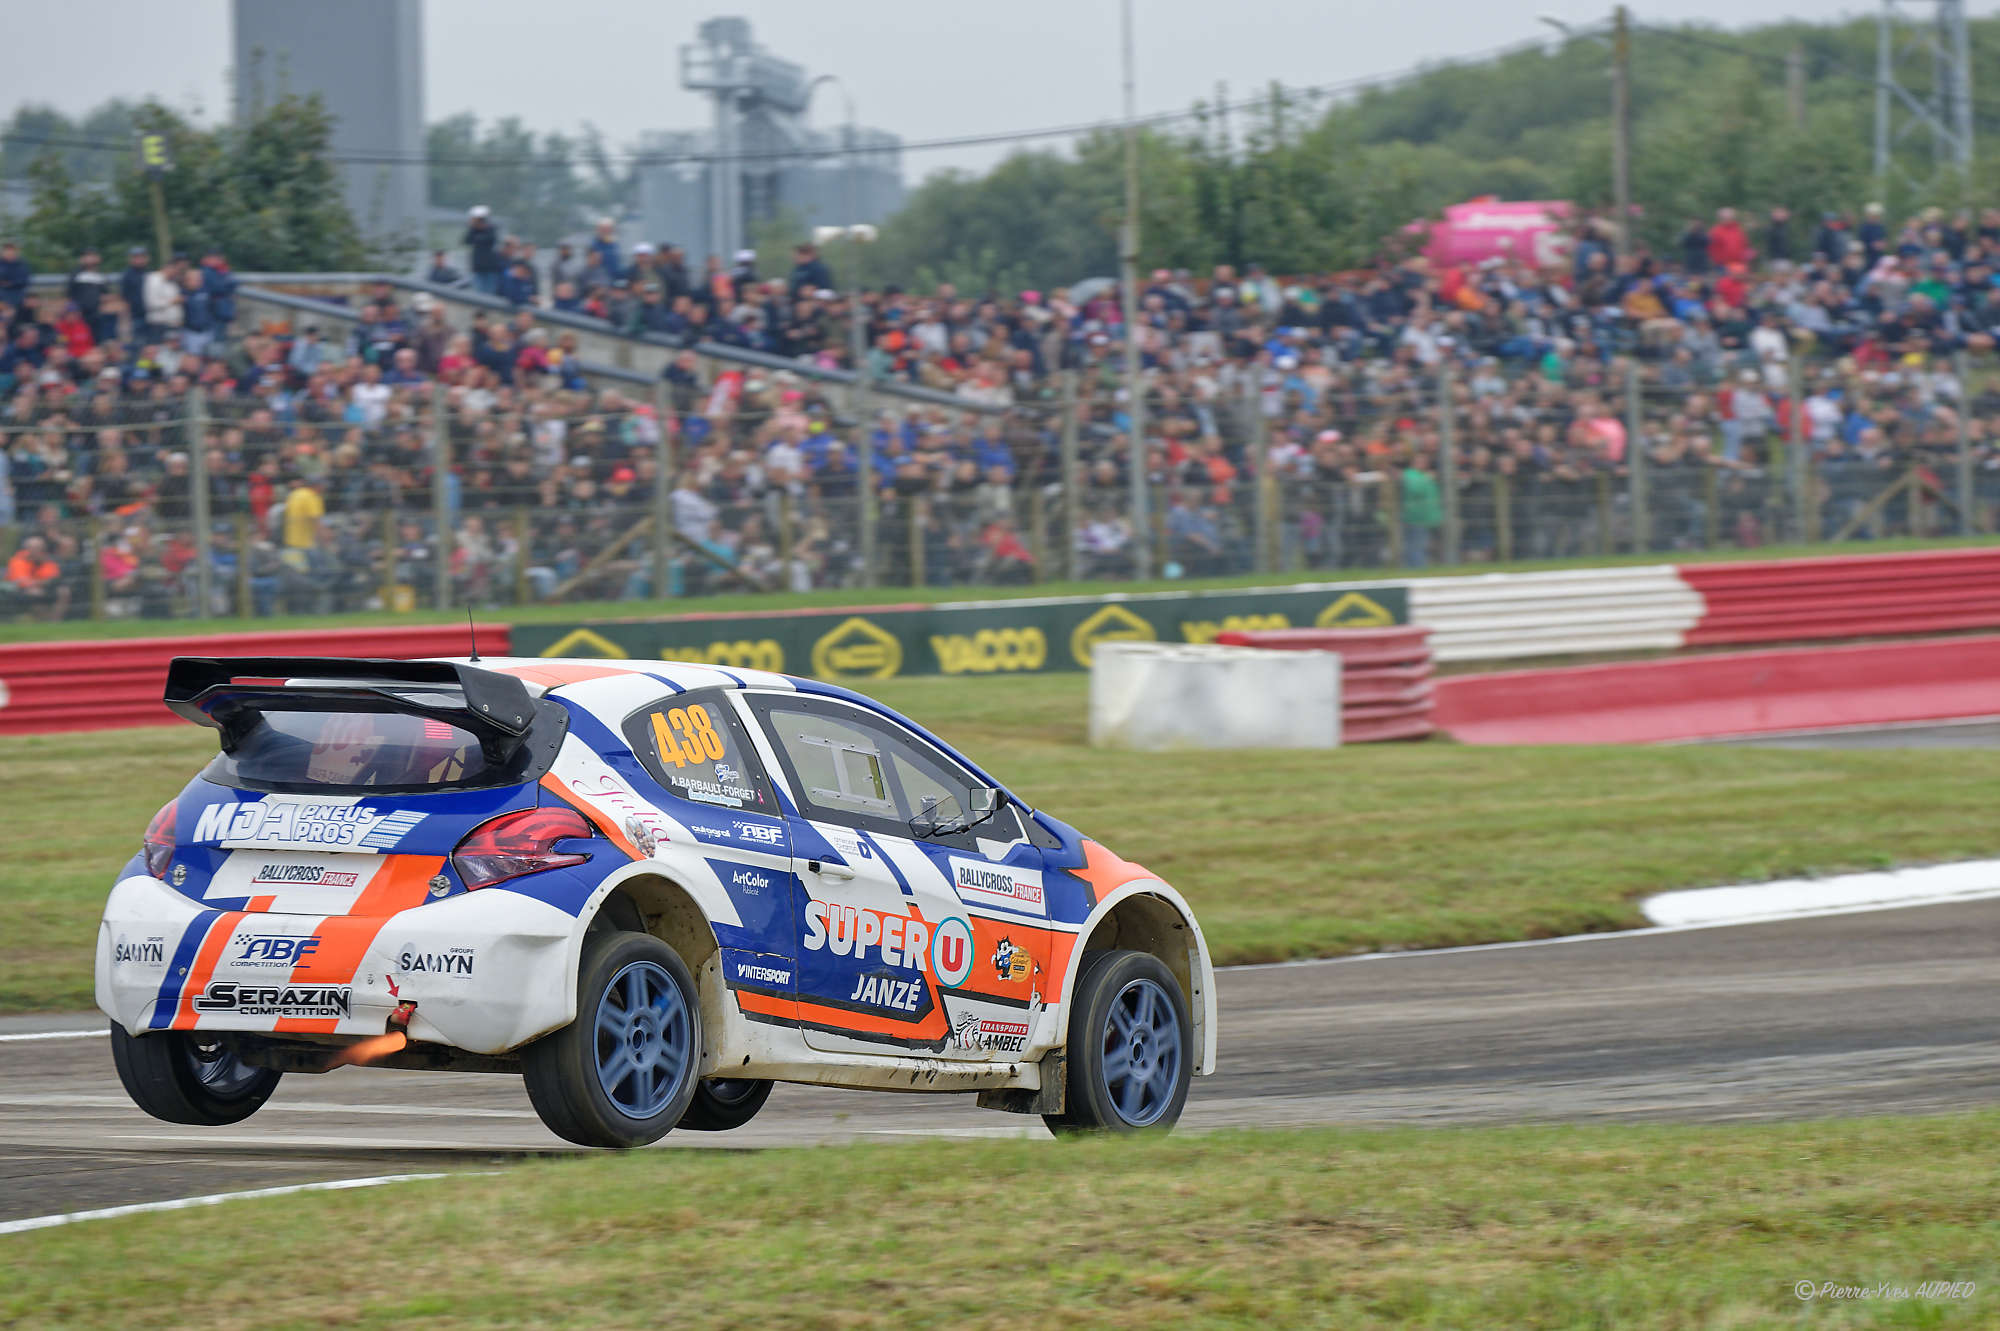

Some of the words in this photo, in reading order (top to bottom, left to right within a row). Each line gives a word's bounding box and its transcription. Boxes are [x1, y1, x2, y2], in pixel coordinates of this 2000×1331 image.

[929, 626, 1047, 674] YACCO
[650, 704, 725, 768] 438
[671, 776, 755, 800] A.BARBAULT-FORGET
[192, 802, 298, 842] MDA
[300, 805, 377, 824] PNEUS
[294, 822, 354, 844] PROS
[741, 825, 783, 844] ABF
[258, 865, 324, 882] RALLYCROSS
[321, 873, 356, 886] FRANCE
[733, 870, 768, 888] ArtColor
[960, 867, 1013, 894] RALLYCROSS
[1015, 885, 1041, 903] FRANCE
[804, 900, 928, 972] SUPER
[942, 936, 964, 972] U
[116, 943, 163, 962] SAMYN
[238, 939, 320, 967] ABF
[401, 952, 473, 974] SAMYN
[745, 965, 790, 985] INTERSPORT
[197, 983, 351, 1019] SERAZIN
[851, 974, 921, 1011] JANZÉ
[240, 1007, 341, 1016] COMPETITION
[981, 1022, 1028, 1035] TRANSPORTS
